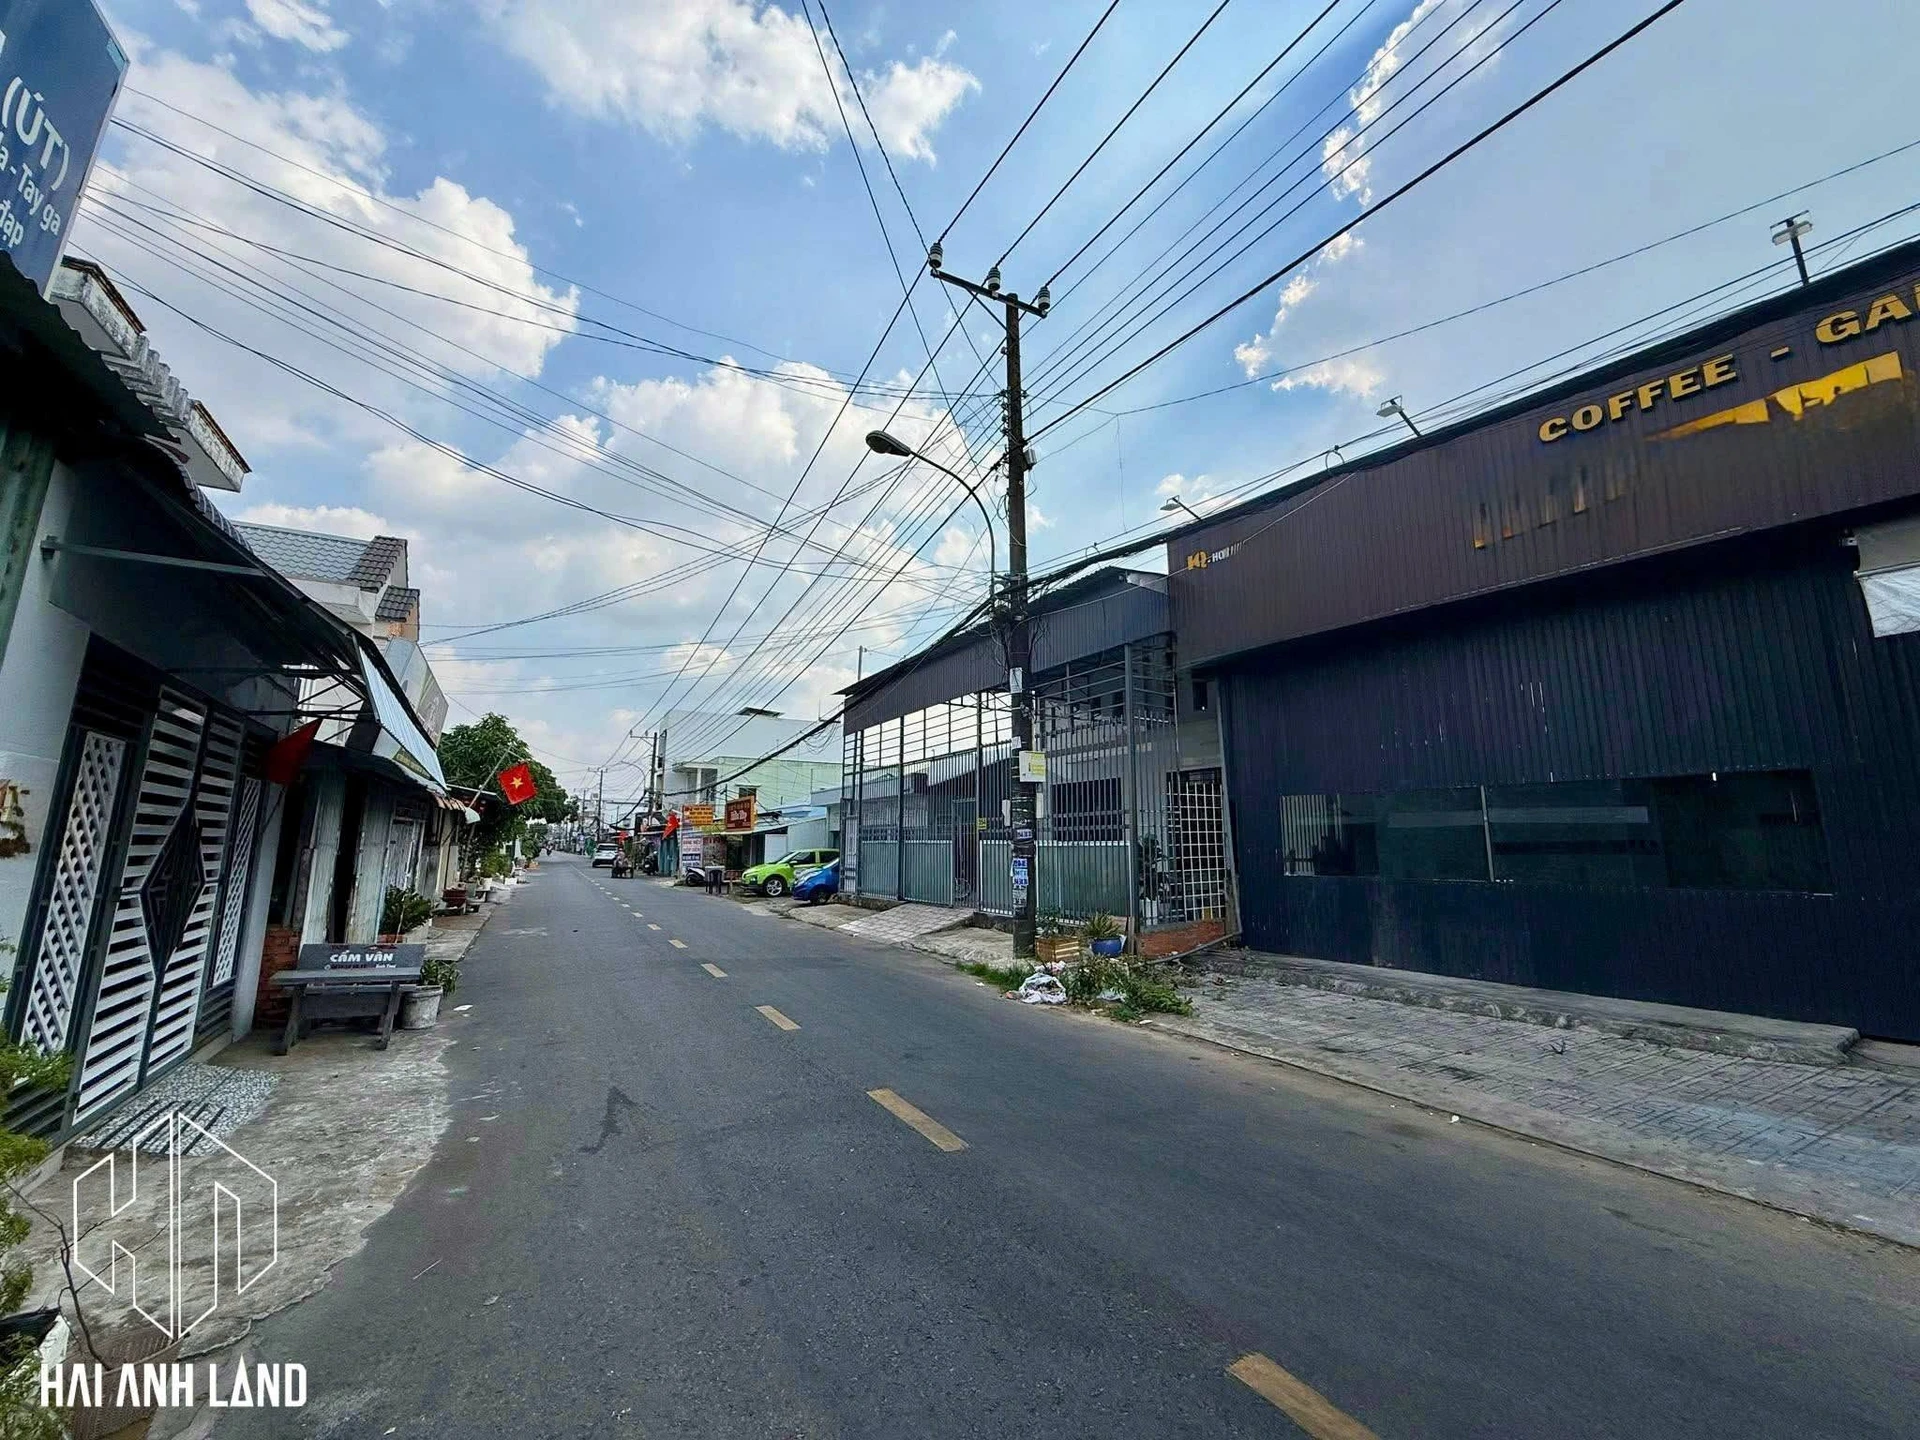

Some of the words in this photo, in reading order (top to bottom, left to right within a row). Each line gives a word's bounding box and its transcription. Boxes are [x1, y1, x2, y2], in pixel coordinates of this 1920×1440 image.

[18, 162, 45, 215] Tay
[39, 203, 62, 236] ga
[1538, 353, 1738, 443] COFFEE
[1815, 279, 1920, 344] GA
